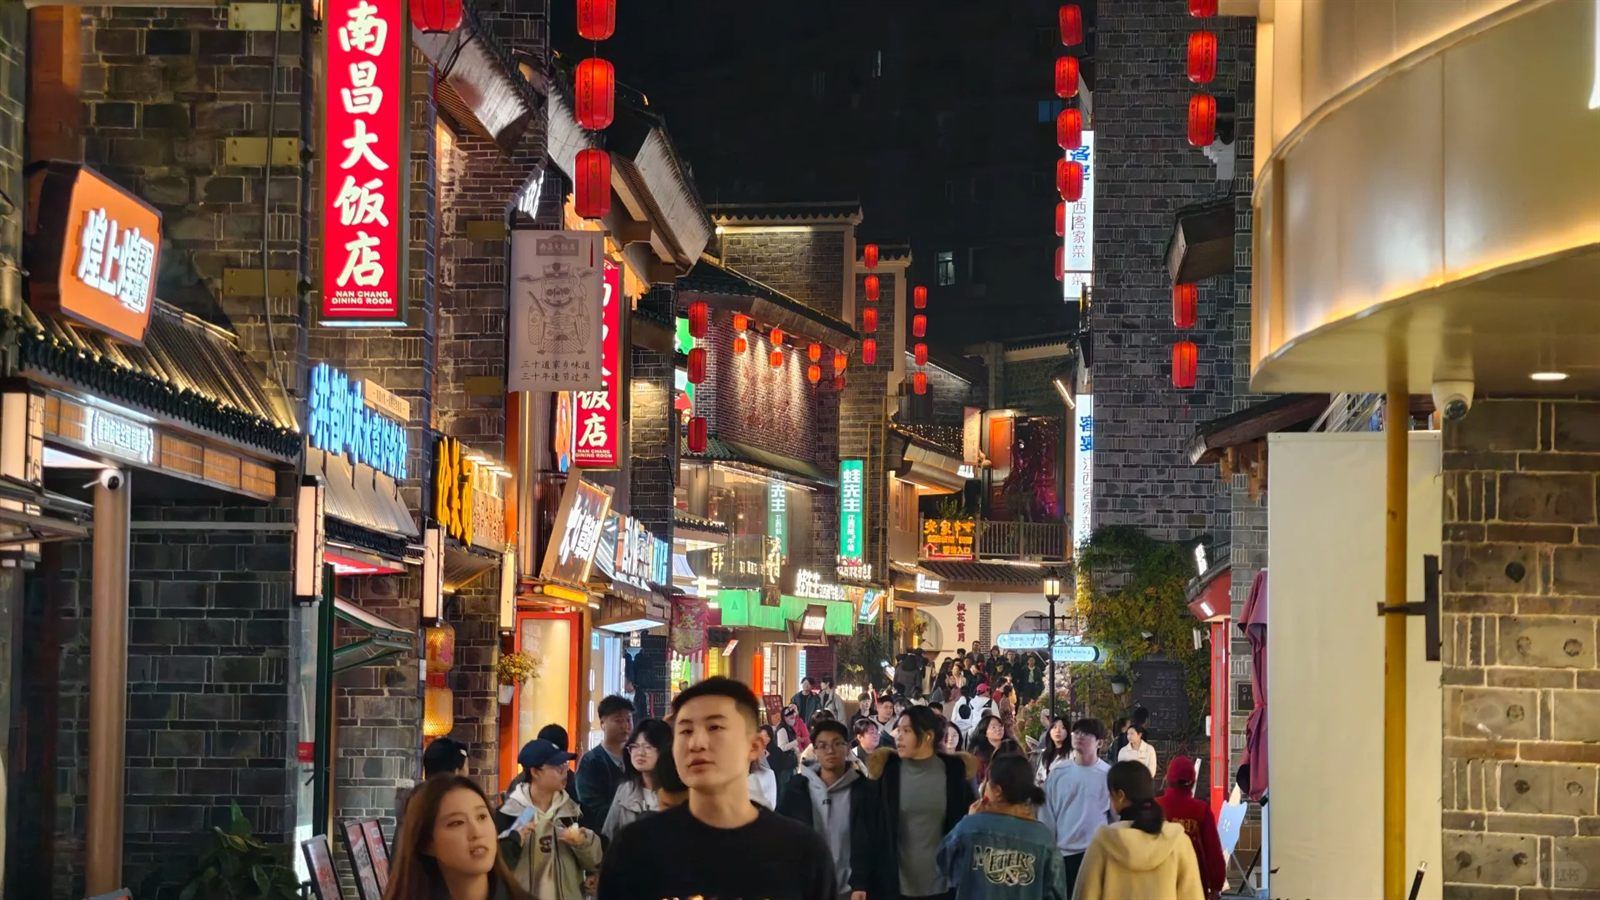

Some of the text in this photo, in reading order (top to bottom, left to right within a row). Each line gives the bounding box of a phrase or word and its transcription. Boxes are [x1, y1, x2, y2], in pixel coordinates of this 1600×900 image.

[334, 1, 390, 288] 南昌大饭店
[336, 290, 389, 298] NAN CHANG
[331, 297, 392, 305] DINING ROOM
